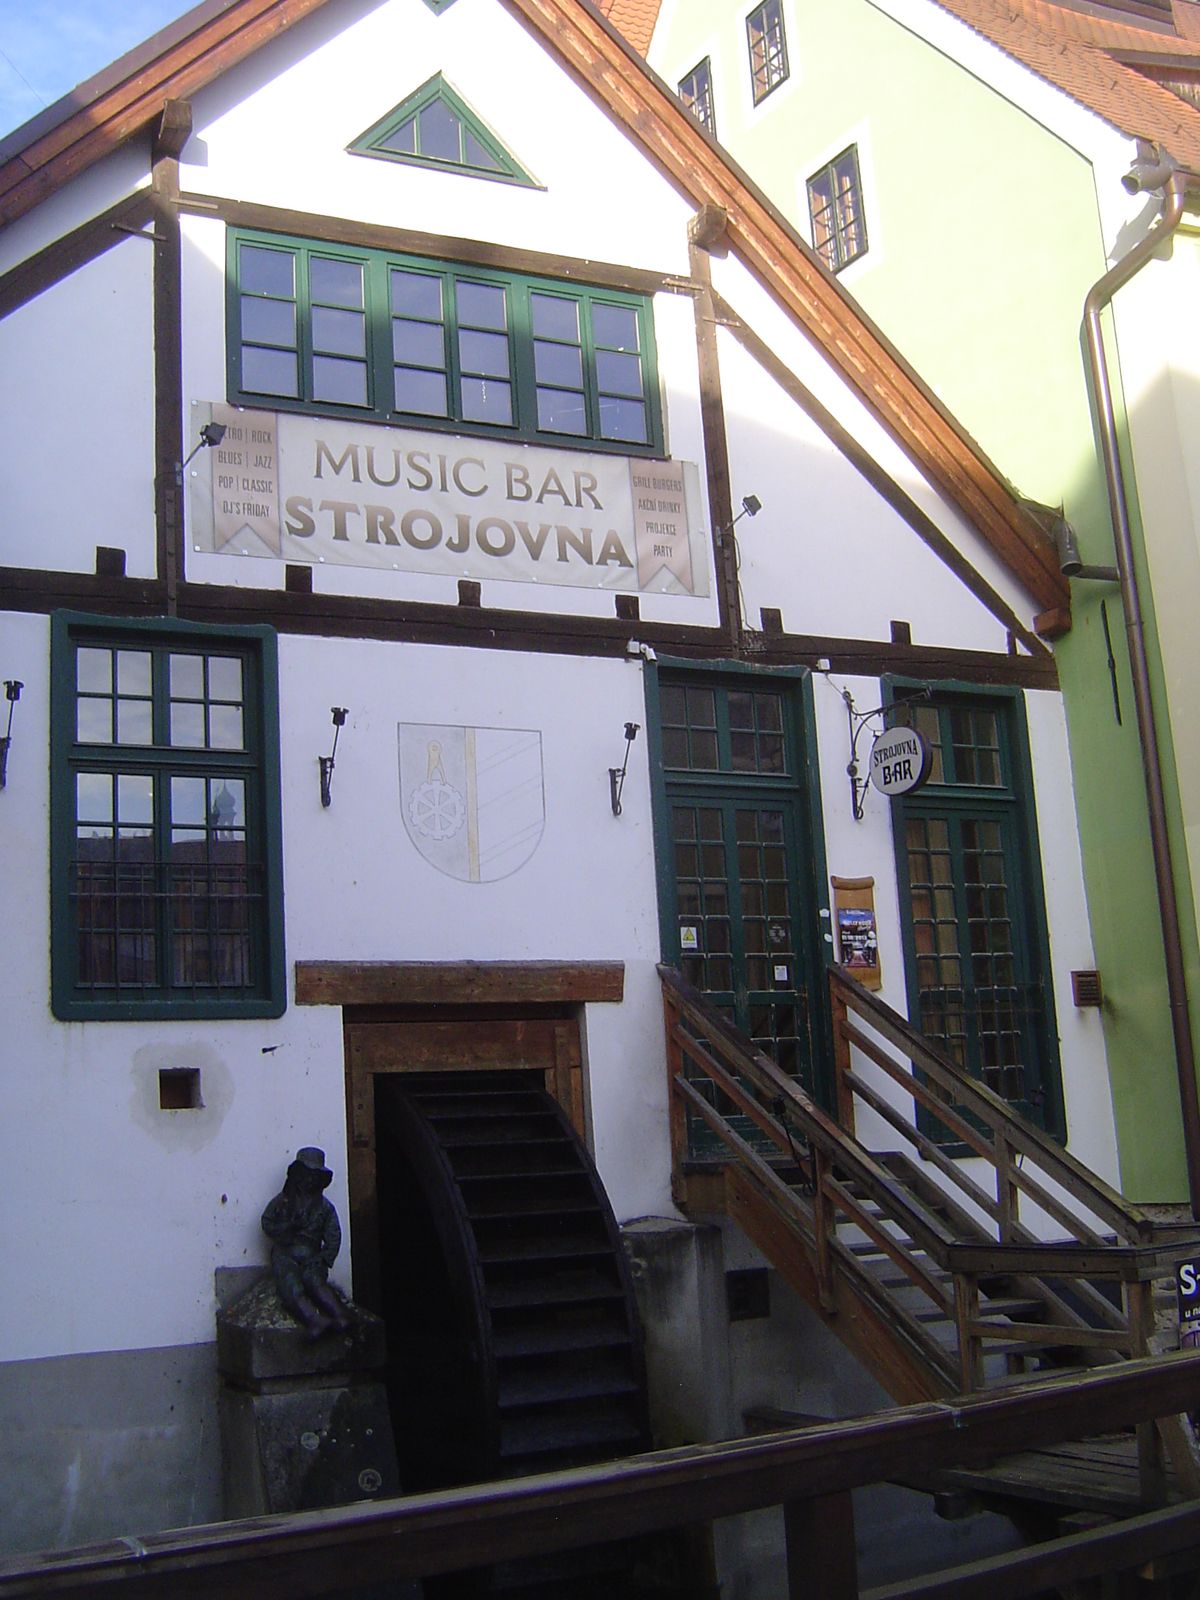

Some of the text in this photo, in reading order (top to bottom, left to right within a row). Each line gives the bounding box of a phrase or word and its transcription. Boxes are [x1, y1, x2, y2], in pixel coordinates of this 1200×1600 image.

[251, 430, 272, 444] ROCK
[218, 450, 272, 469] BLUES JAZZ
[218, 475, 273, 494] POP CLASSIC
[314, 440, 604, 510] MUSIC BAR
[632, 475, 651, 489] GRILL
[223, 500, 270, 517] DJ'S FRIDAY
[285, 496, 634, 569] STROJOVNA
[646, 521, 677, 536] PROJEKCE
[653, 544, 673, 558] PARTY
[873, 739, 918, 768] STROJOVNA
[882, 758, 913, 786] BAR
